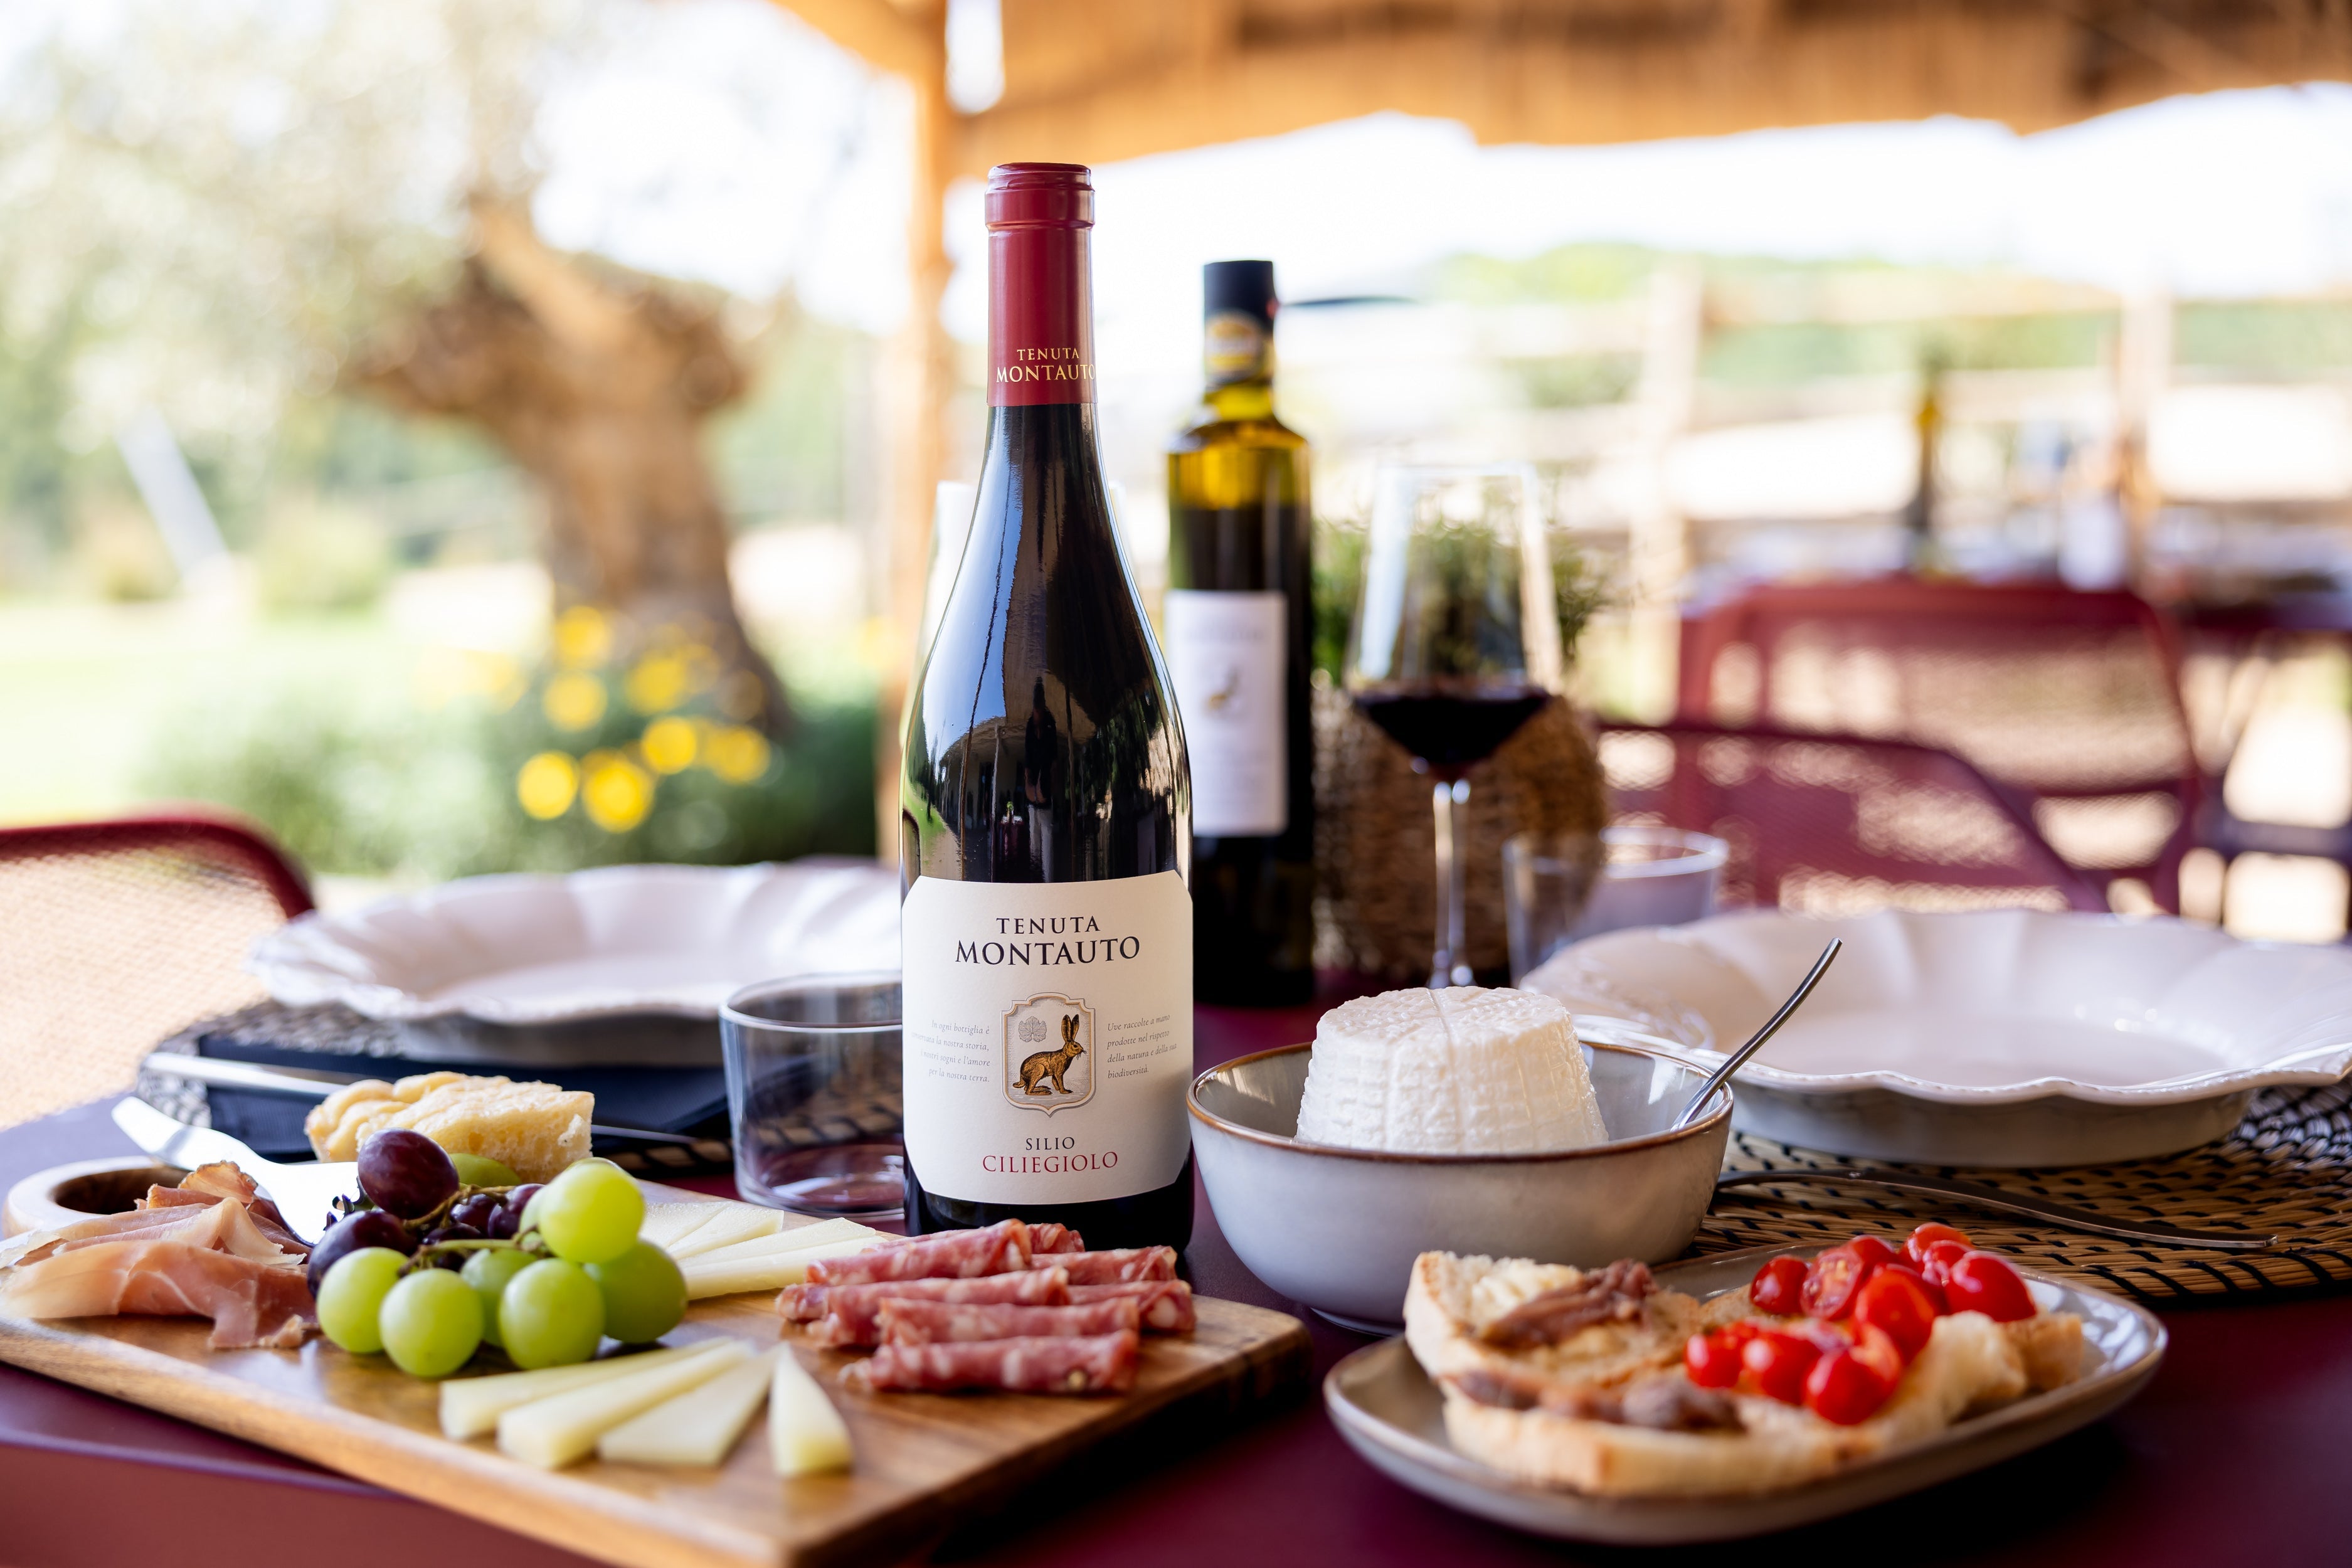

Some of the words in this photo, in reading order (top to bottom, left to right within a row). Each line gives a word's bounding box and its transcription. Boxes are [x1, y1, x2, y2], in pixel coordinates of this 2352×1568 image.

[1016, 347, 1079, 361] TENUTA
[996, 363, 1095, 383] MONTAUTO
[996, 916, 1101, 935] TENUTA
[955, 936, 1140, 966] MONTAUTO
[931, 1020, 937, 1028] In
[939, 1024, 951, 1032] ogni
[954, 1023, 983, 1036] bottiglia
[985, 1025, 990, 1034] è
[1108, 1023, 1121, 1031] Uve
[1124, 1017, 1149, 1029] raccolte
[1156, 1015, 1170, 1023] mano
[936, 1036, 941, 1044] la
[943, 1040, 963, 1048] nostra
[965, 1042, 989, 1051] storia,
[1106, 1037, 1136, 1050] prodotte
[1138, 1032, 1148, 1042] nel
[1150, 1030, 1170, 1041] rispetto
[924, 1051, 938, 1060] nostri
[940, 1056, 956, 1064] sogni
[1107, 1053, 1125, 1062] della
[1127, 1051, 1148, 1060] natura
[1155, 1044, 1168, 1055] della
[928, 1068, 938, 1077] per
[939, 1068, 945, 1077] la
[970, 1074, 990, 1083] terra.
[1108, 1064, 1149, 1078] biodiversità.
[1025, 1136, 1075, 1150] SILIO
[982, 1152, 1118, 1173] CILIEGIOLO
